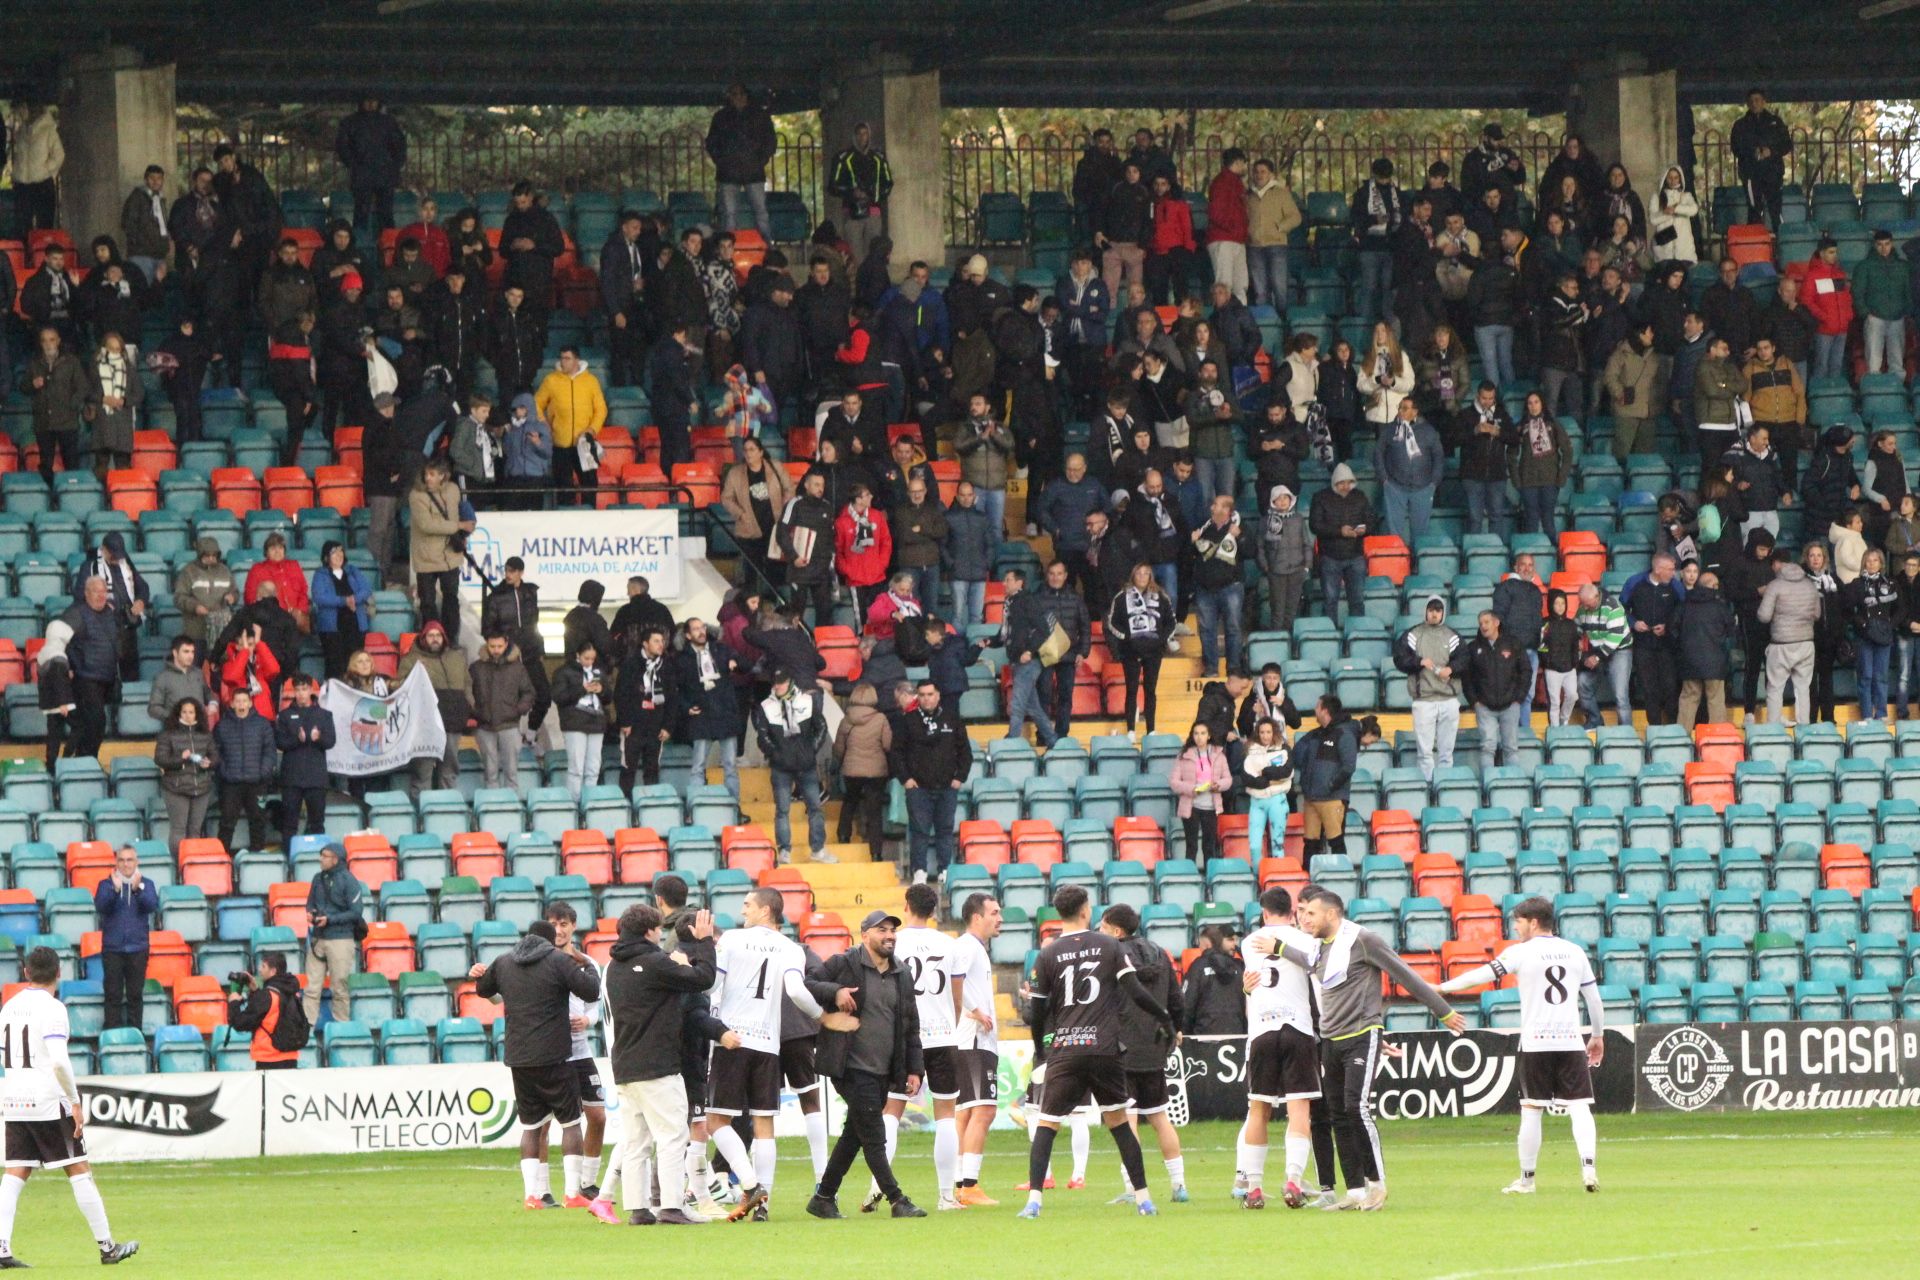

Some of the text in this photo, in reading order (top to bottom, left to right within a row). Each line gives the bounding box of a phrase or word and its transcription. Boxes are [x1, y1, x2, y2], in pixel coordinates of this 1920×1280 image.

[521, 535, 673, 557] MINIMARKET
[538, 559, 659, 575] MIRANDA DE AZÁN
[745, 957, 771, 1000] 4
[903, 955, 946, 996] 23
[1058, 960, 1101, 1007] 13
[1544, 964, 1568, 1006] 8
[1666, 1032, 1708, 1049] LA CASA
[1741, 1028, 1787, 1076] LA
[1800, 1026, 1896, 1075] CASA
[1676, 1053, 1699, 1084] CP
[81, 1092, 192, 1131] JOMAR
[280, 1087, 494, 1123] SANMAXIMO
[1661, 1081, 1715, 1106] DE LAS PULGAS
[350, 1121, 478, 1149] TELECOM
